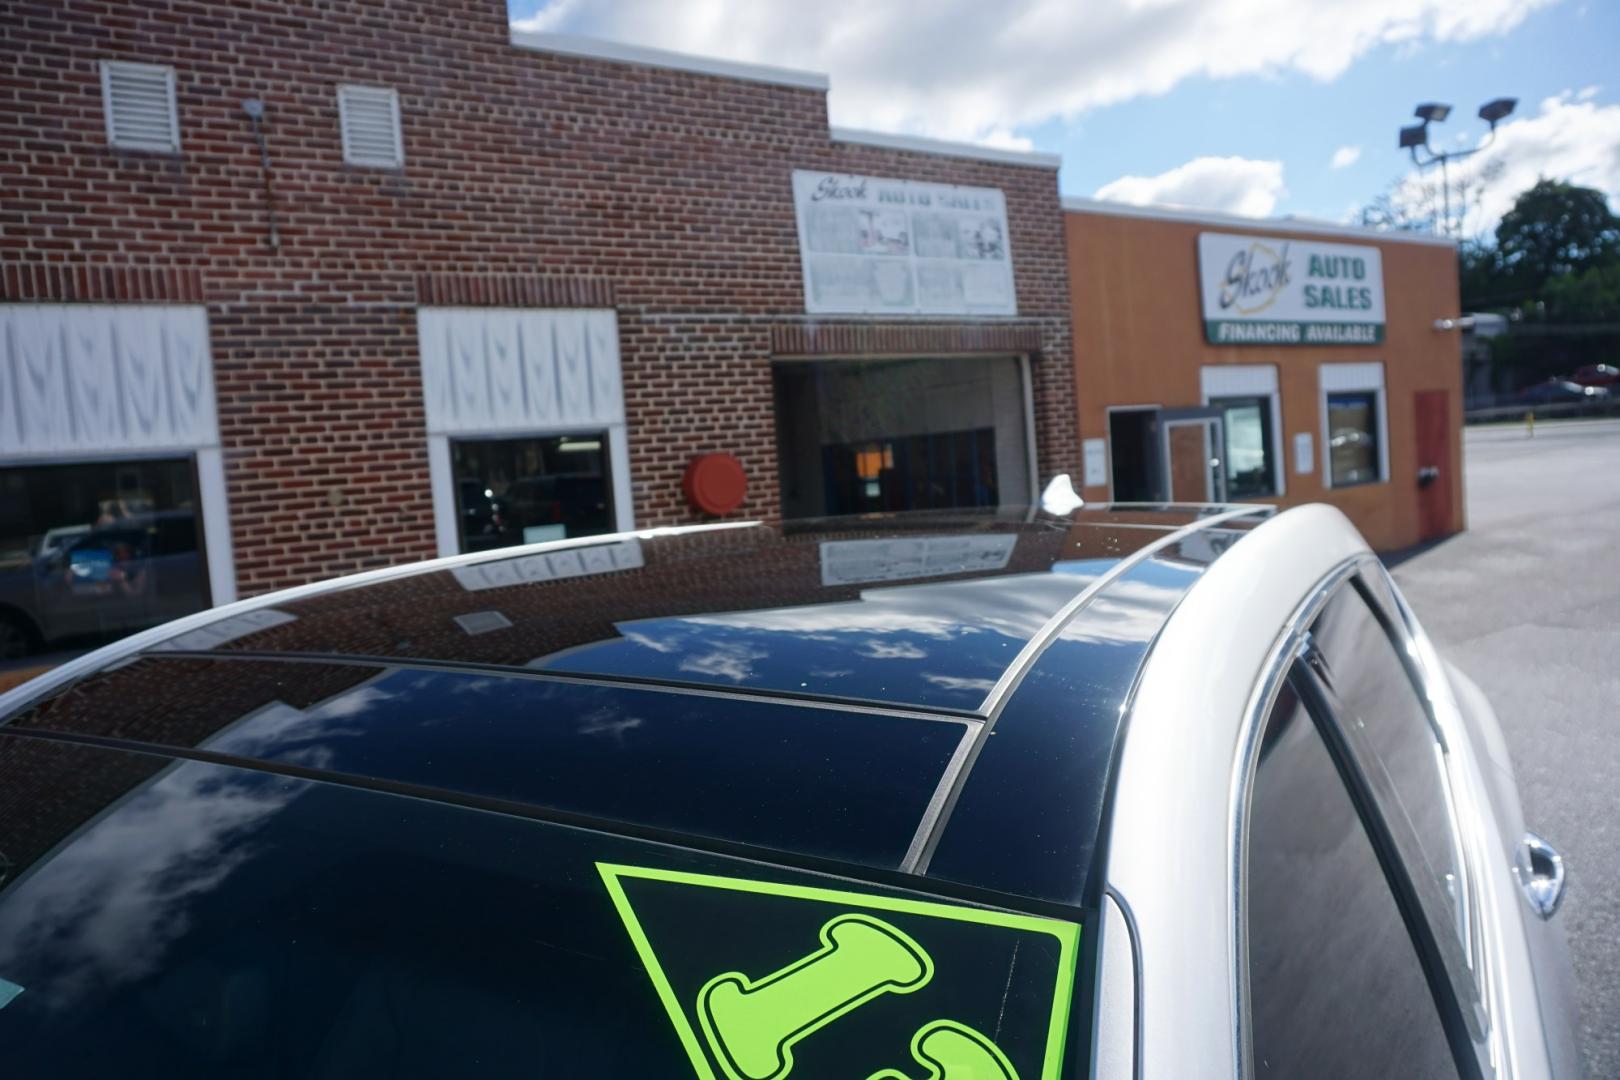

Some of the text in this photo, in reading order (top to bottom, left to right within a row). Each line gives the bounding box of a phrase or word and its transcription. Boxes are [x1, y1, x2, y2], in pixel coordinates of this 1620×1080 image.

[1307, 253, 1366, 281] AUTO
[1303, 285, 1373, 311] SALES
[1218, 322, 1376, 342] FINANCING AVAILABLE
